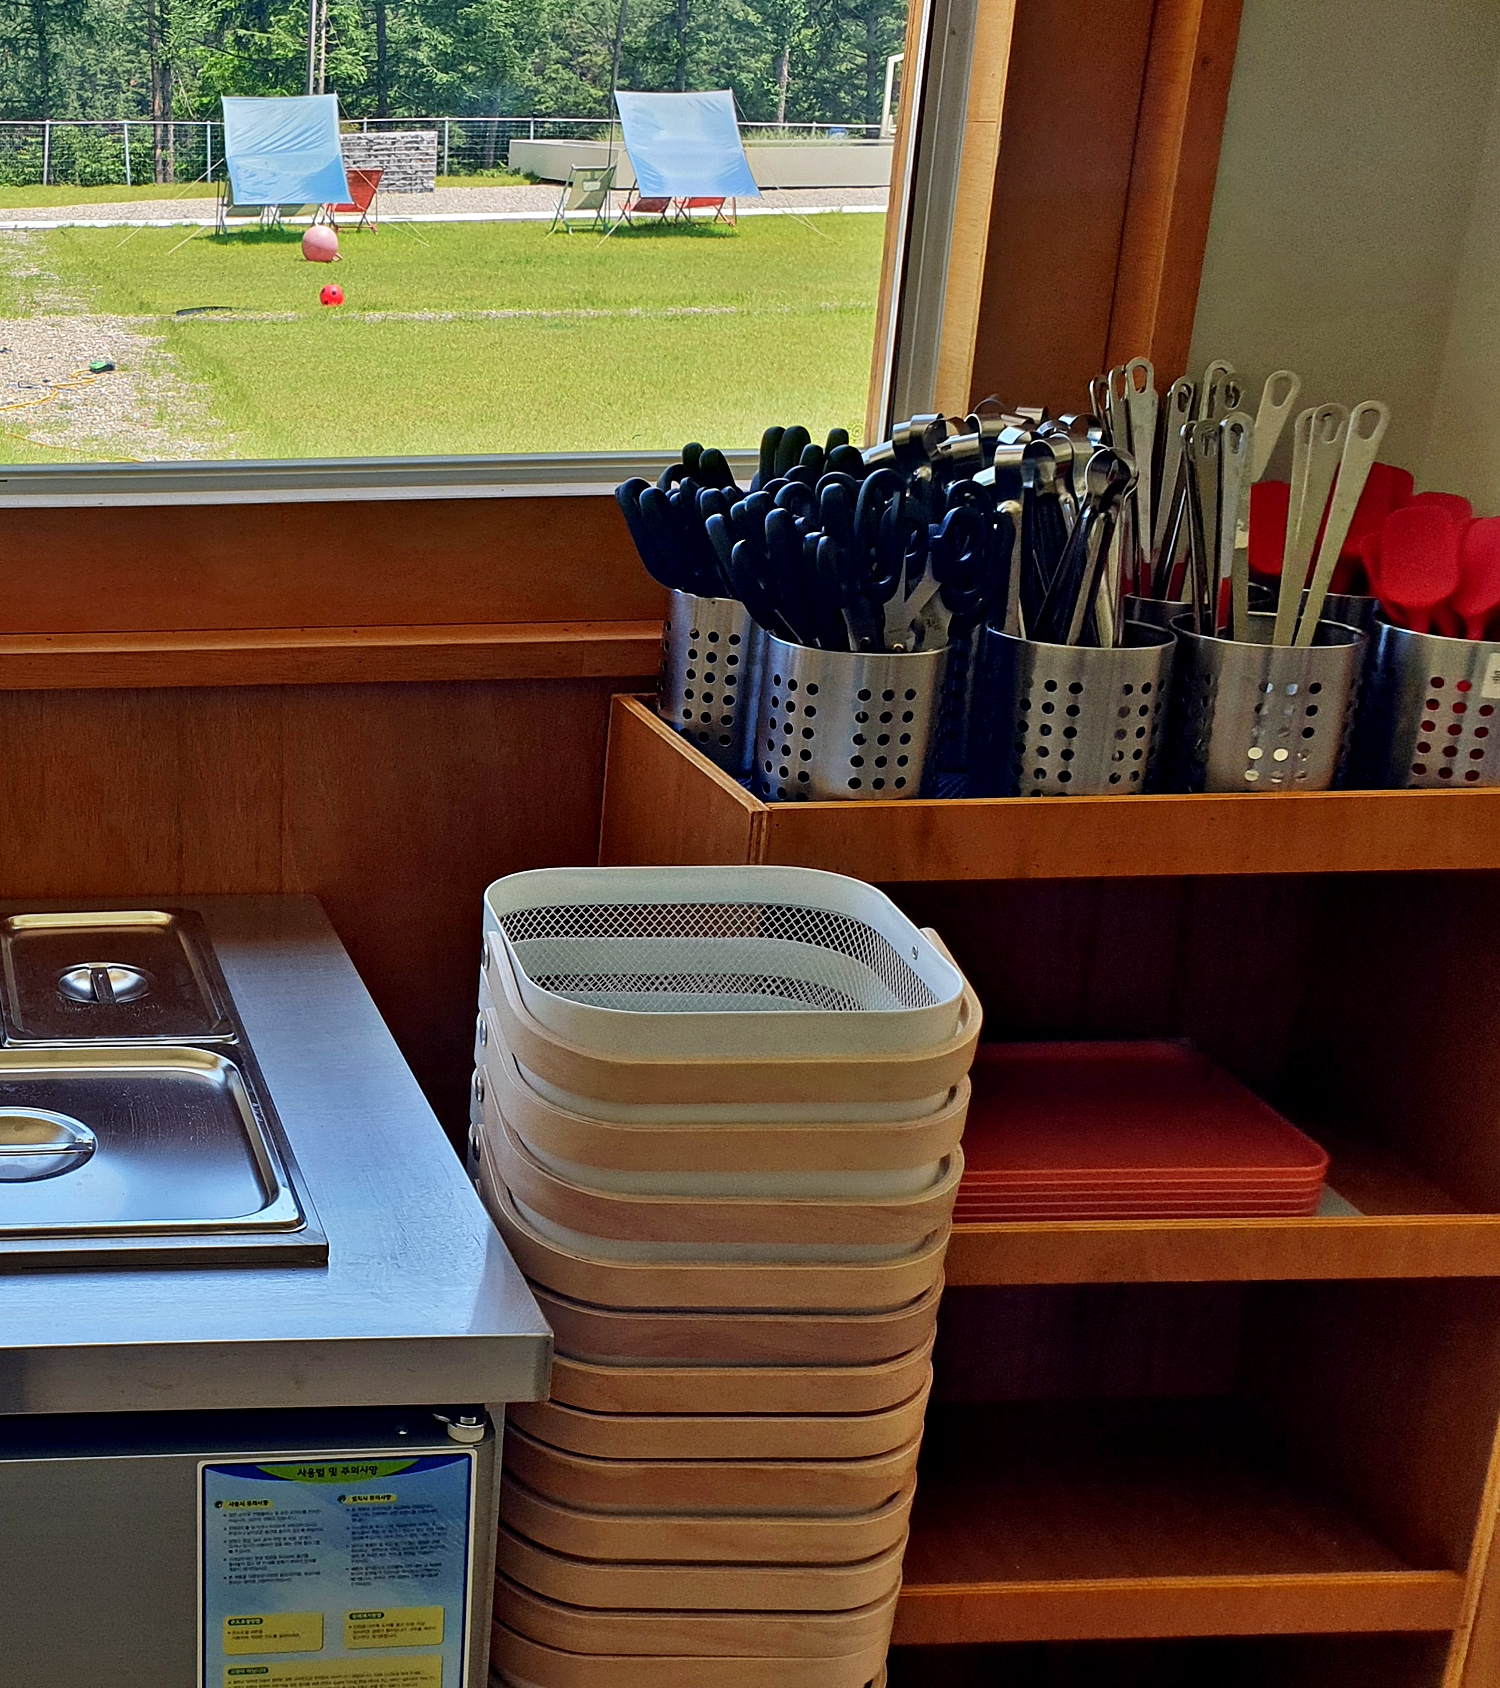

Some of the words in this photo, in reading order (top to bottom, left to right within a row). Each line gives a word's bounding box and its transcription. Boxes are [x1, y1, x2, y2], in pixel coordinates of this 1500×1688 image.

[297, 1467, 325, 1479] 사용법
[328, 1467, 338, 1477] 및
[341, 1465, 379, 1476] 주의사항
